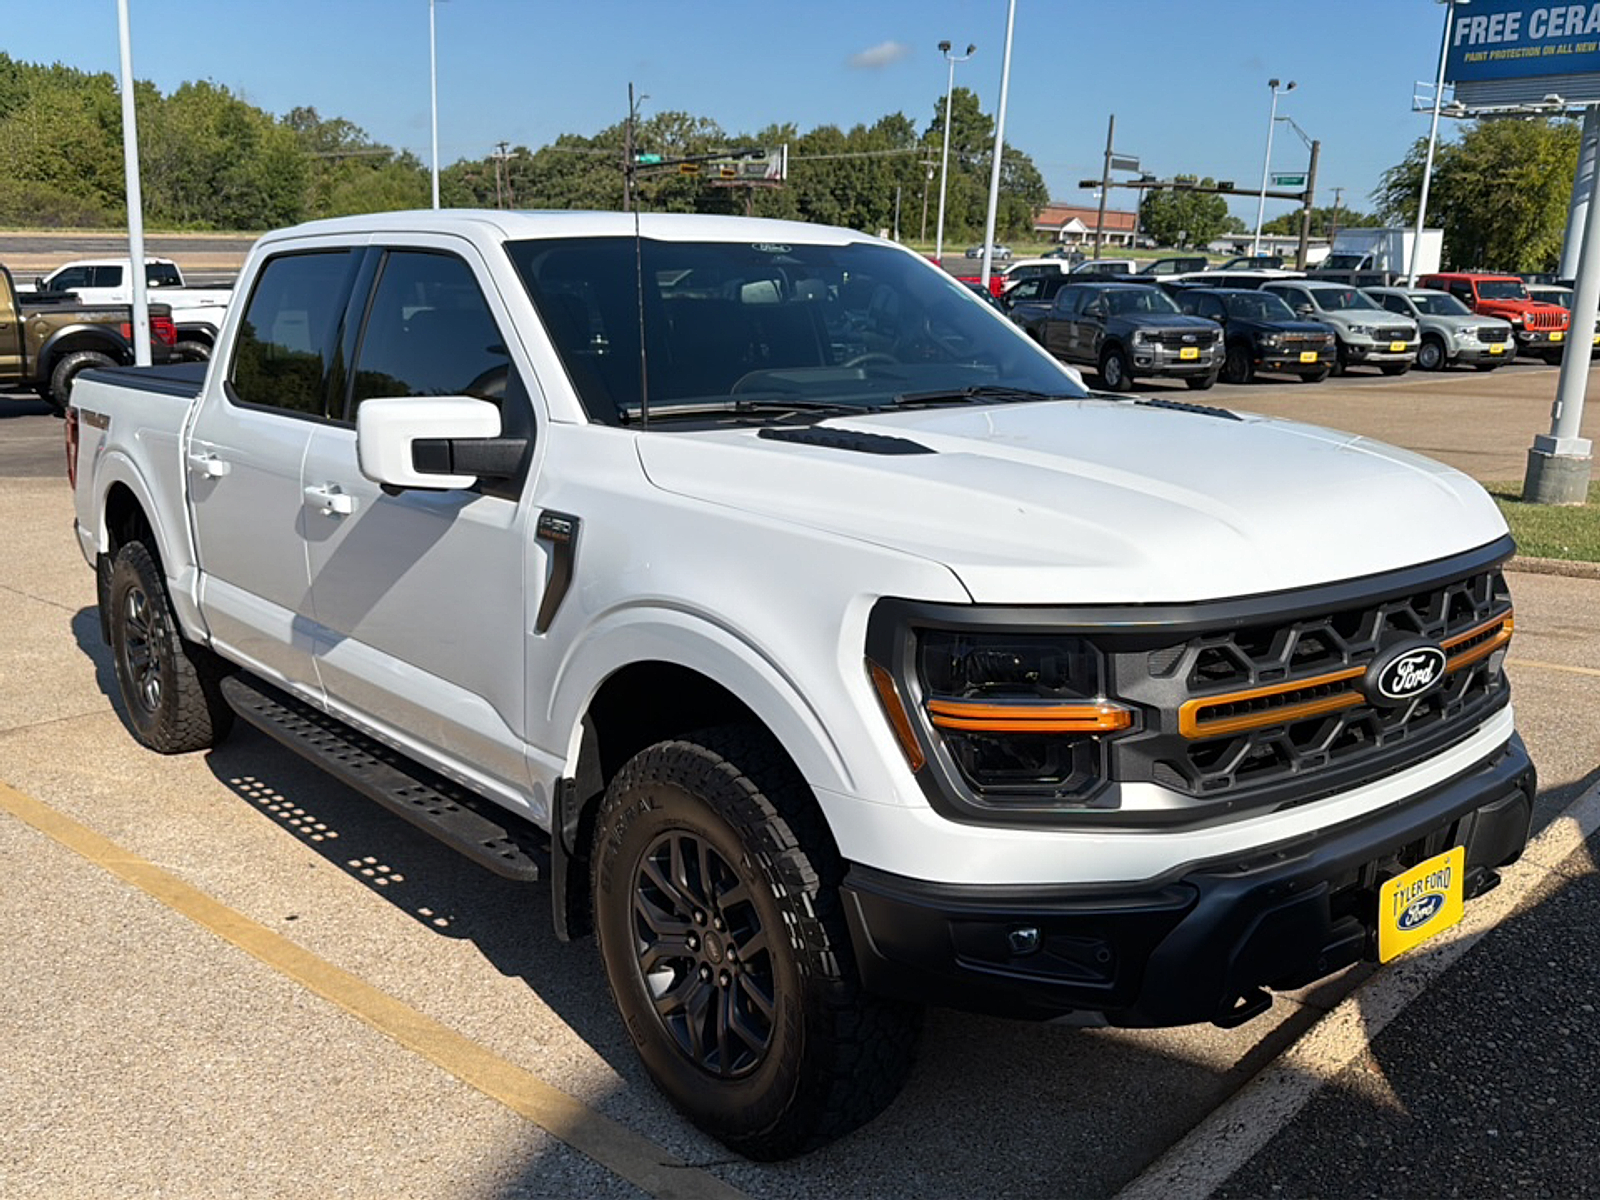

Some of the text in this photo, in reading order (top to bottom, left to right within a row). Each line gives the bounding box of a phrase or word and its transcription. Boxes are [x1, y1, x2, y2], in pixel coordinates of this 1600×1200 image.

[1453, 11, 1522, 46] FREE
[1464, 41, 1598, 62] PAINT PROTECTION ON ALL NEW
[1392, 654, 1435, 693] Ford
[1393, 866, 1451, 917] TYLER FORD
[1405, 897, 1436, 926] Ford
